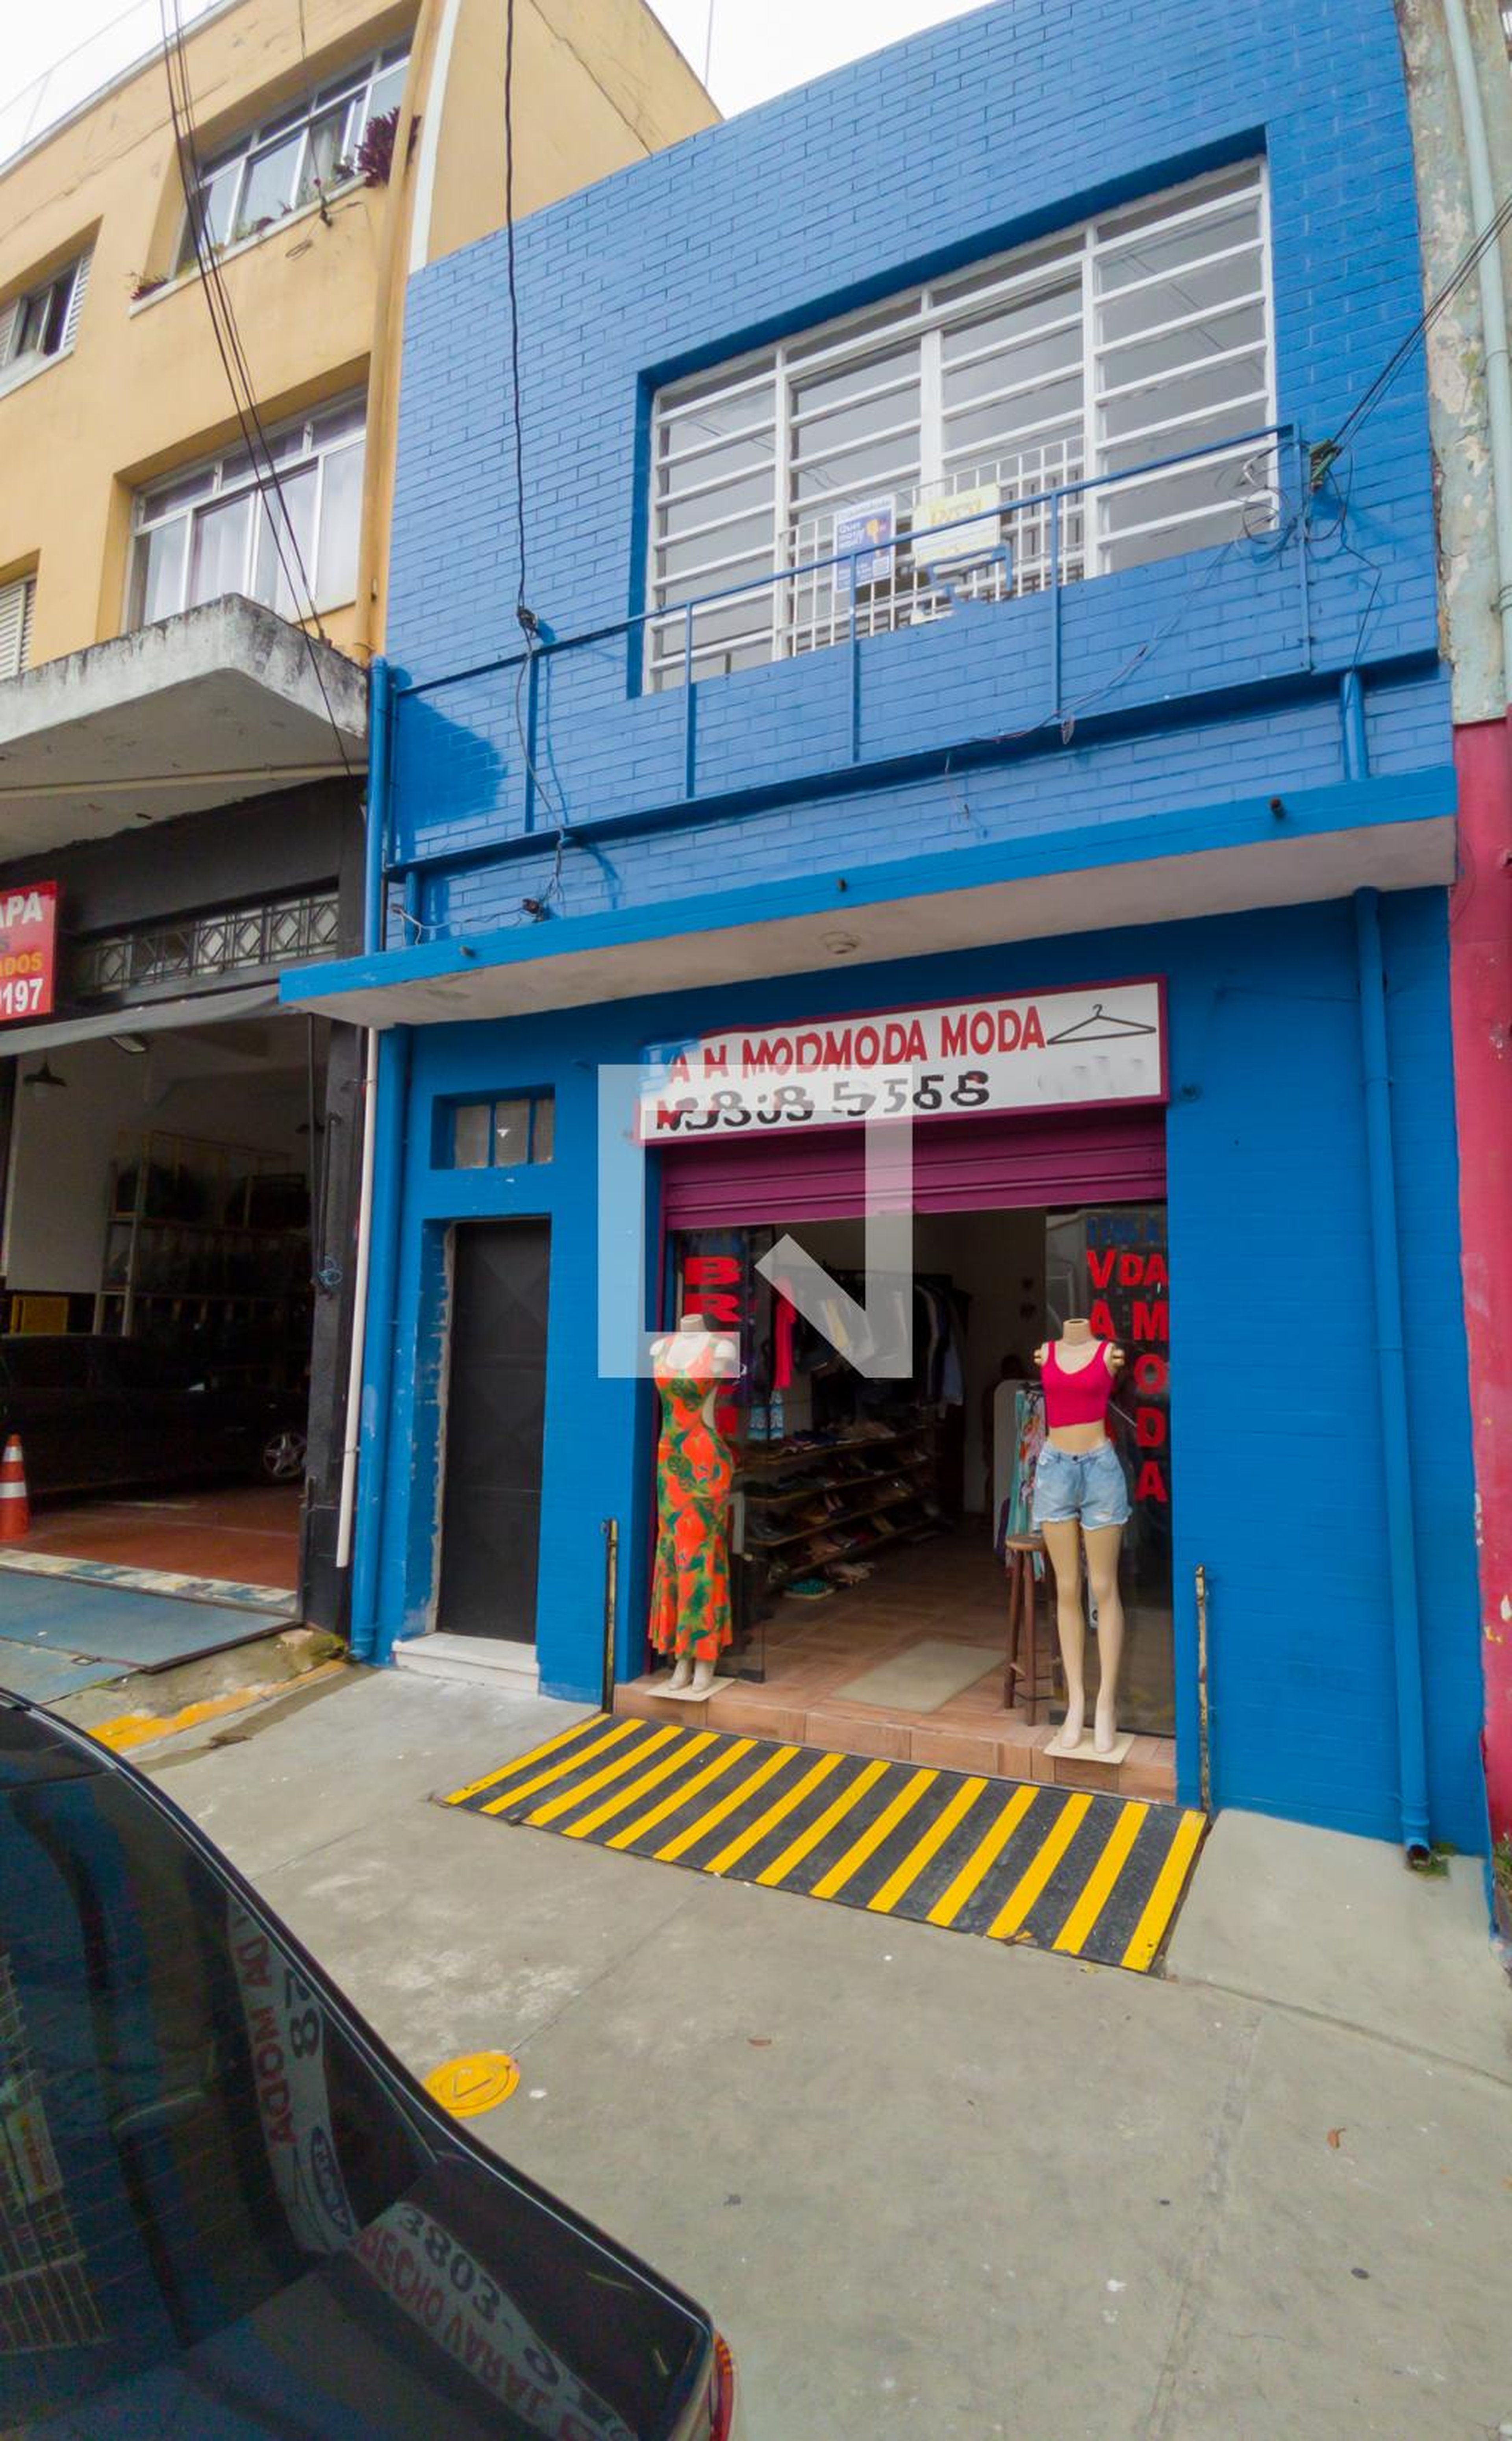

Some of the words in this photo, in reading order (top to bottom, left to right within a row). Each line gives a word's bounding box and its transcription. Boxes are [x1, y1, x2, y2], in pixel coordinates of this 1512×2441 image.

[0, 892, 43, 929] PA
[0, 952, 43, 976] DOS
[0, 978, 43, 1014] 197
[941, 1005, 1045, 1058] MODA
[1132, 1301, 1169, 1503] MODA
